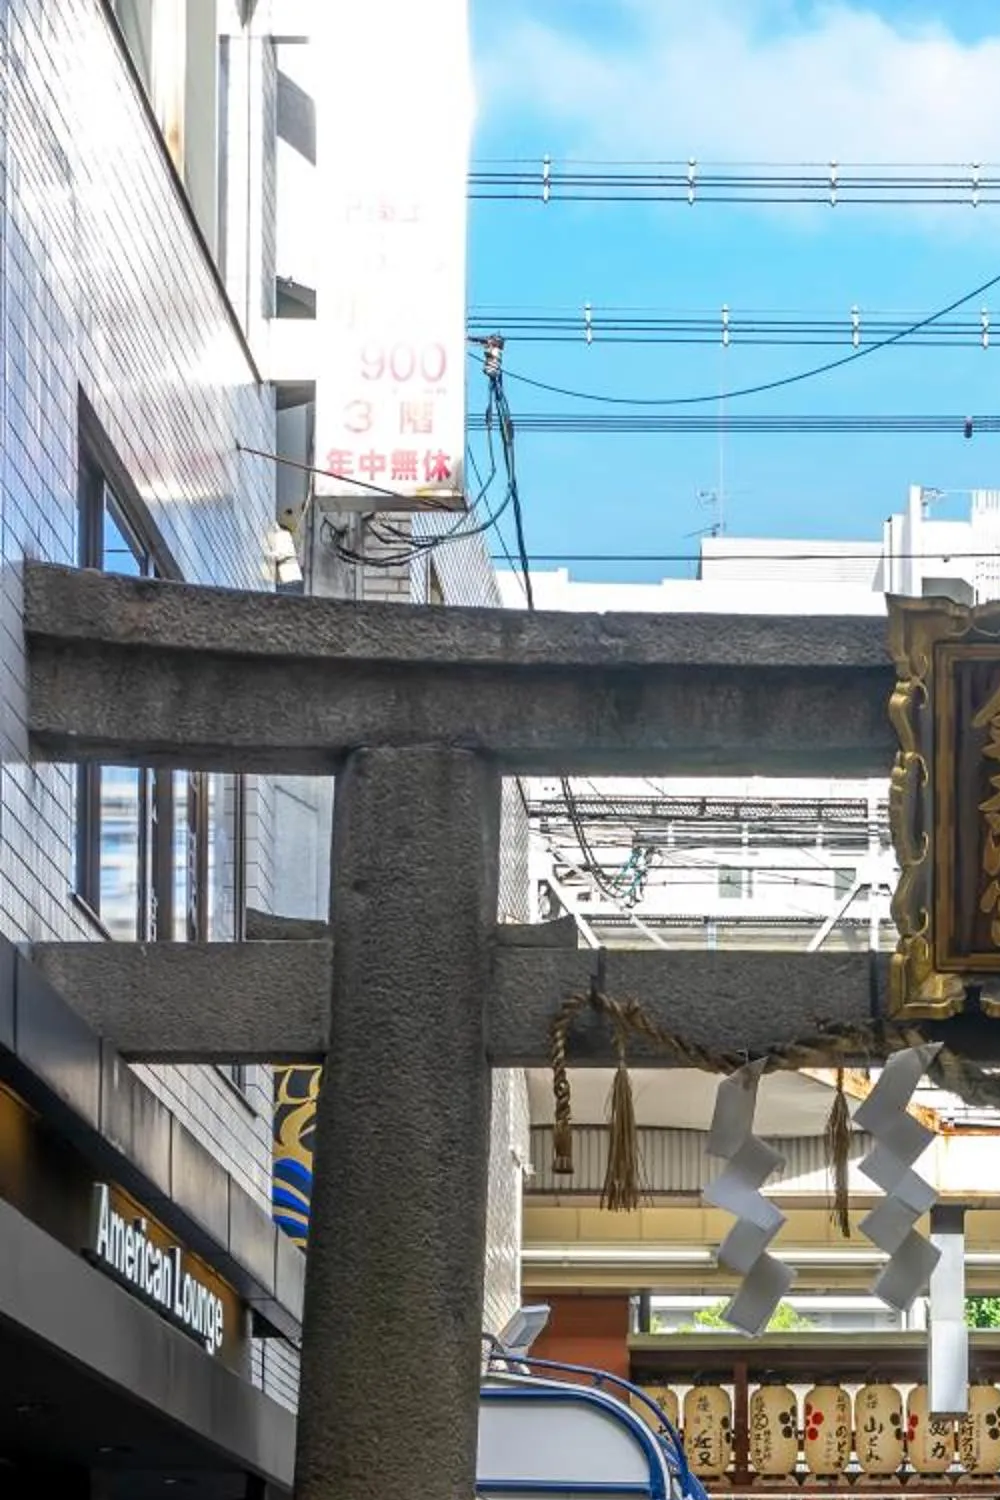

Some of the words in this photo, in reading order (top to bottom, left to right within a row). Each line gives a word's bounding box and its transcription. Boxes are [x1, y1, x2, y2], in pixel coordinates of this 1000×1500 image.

[325, 447, 453, 482] 年中無休
[95, 1182, 172, 1310] American
[173, 1246, 224, 1354] Lounge
